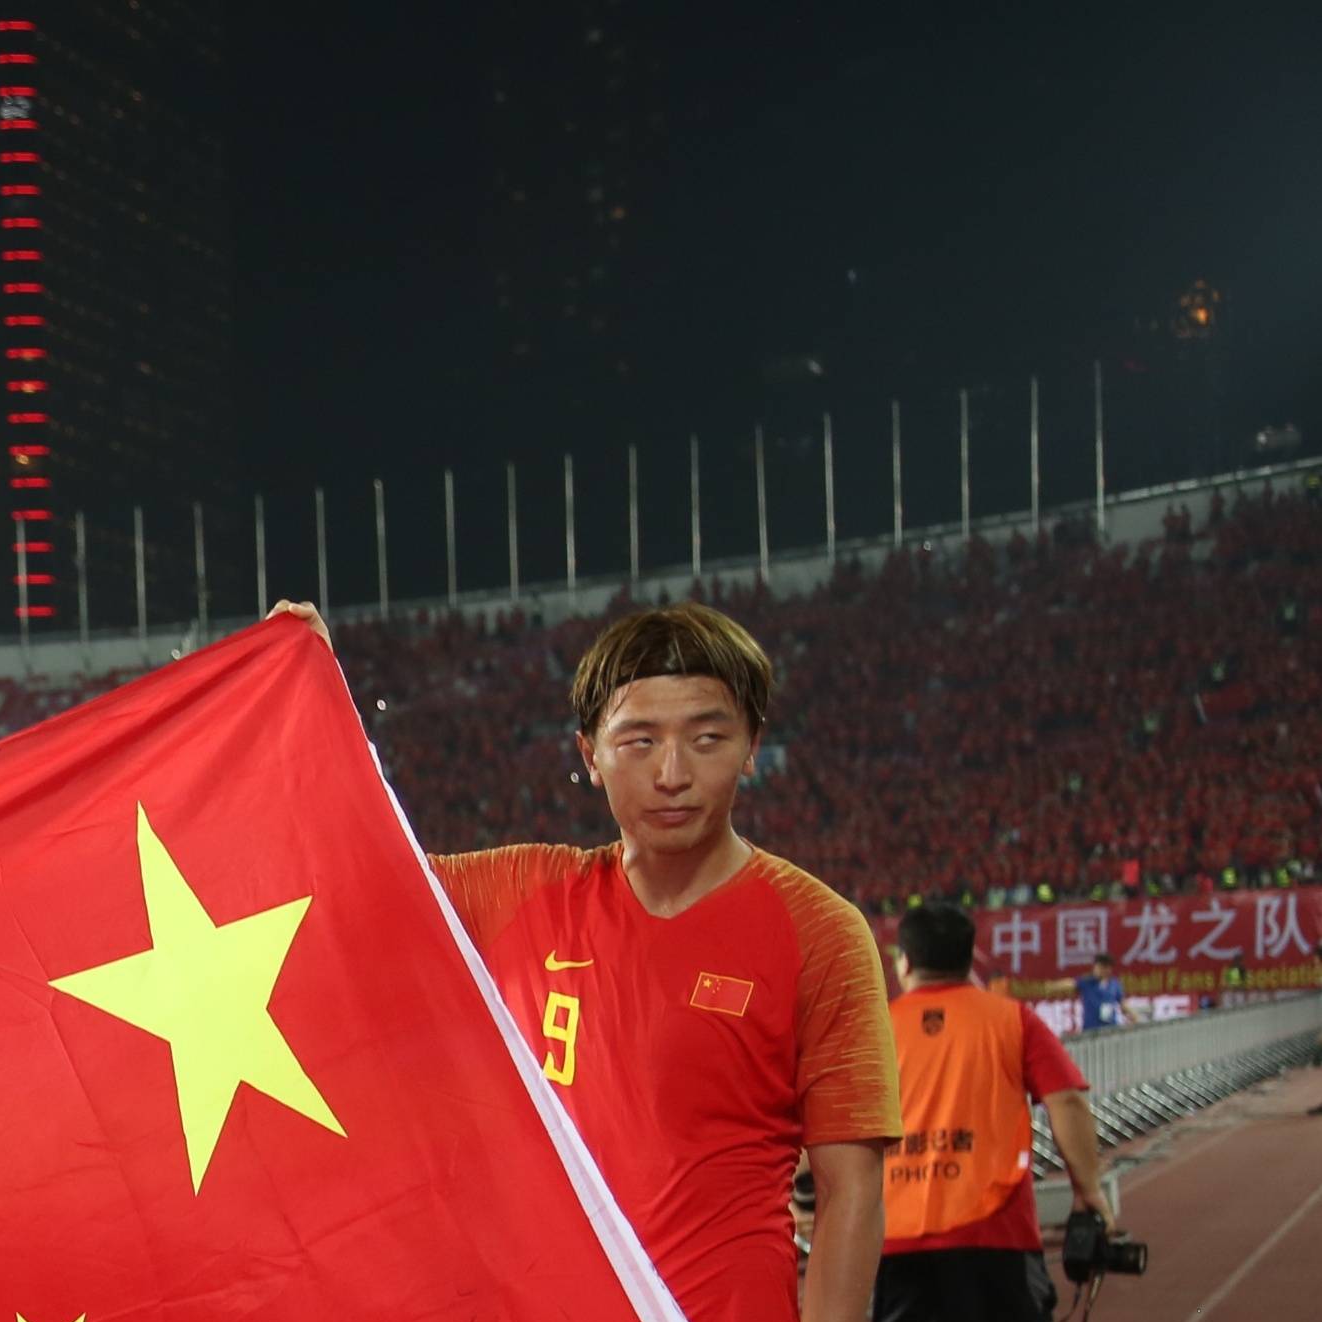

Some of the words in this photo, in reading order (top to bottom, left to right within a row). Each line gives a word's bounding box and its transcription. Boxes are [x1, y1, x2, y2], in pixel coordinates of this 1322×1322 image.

[992, 893, 1312, 973] 中国龙之队
[543, 991, 580, 1086] 9
